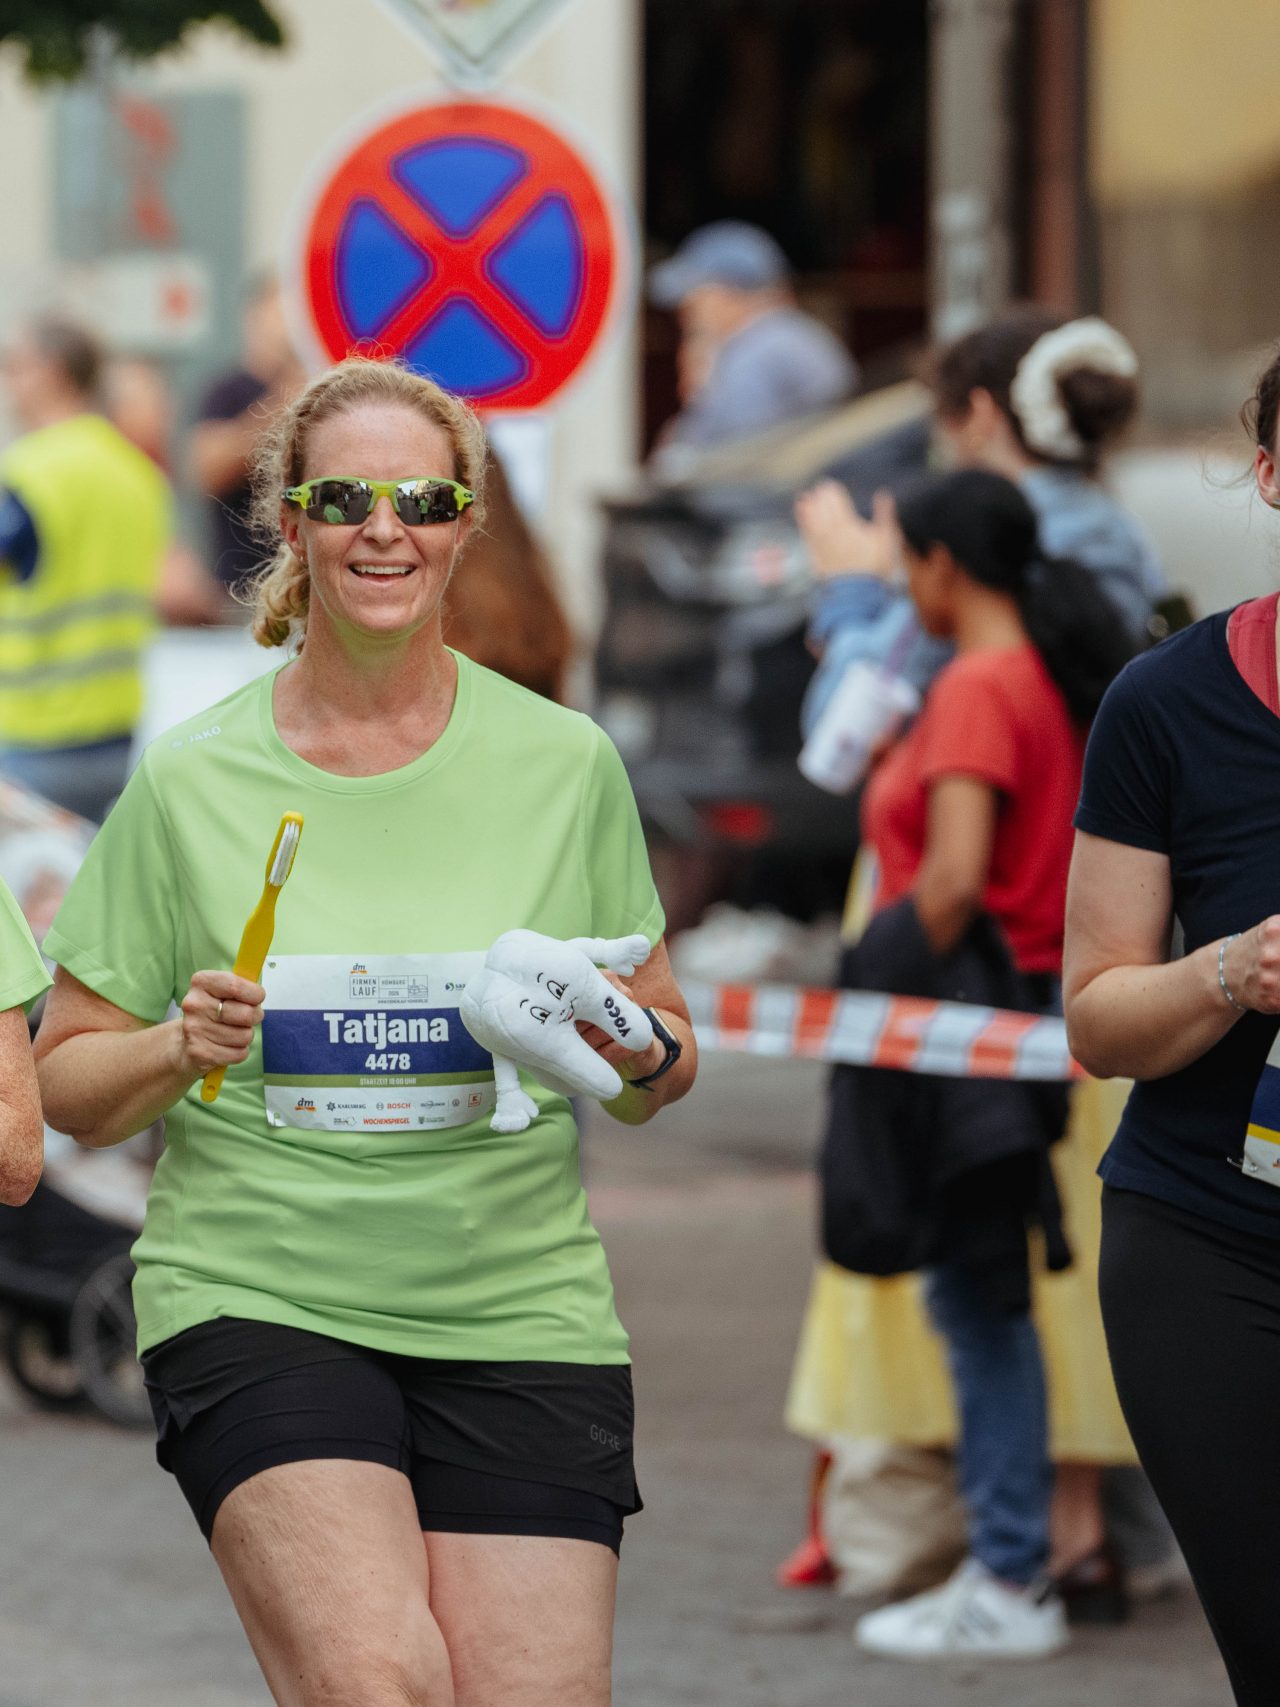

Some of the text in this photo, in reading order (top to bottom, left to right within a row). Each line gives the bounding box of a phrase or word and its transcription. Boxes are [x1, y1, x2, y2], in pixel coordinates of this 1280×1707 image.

[188, 725, 222, 743] JAKO
[352, 986, 376, 996] LAUF
[323, 1013, 449, 1050] Tatjana
[365, 1053, 411, 1071] 4478
[297, 1098, 314, 1106] dm
[363, 1117, 410, 1125] WOCHENSPIEGEL
[590, 1424, 622, 1451] GORE
